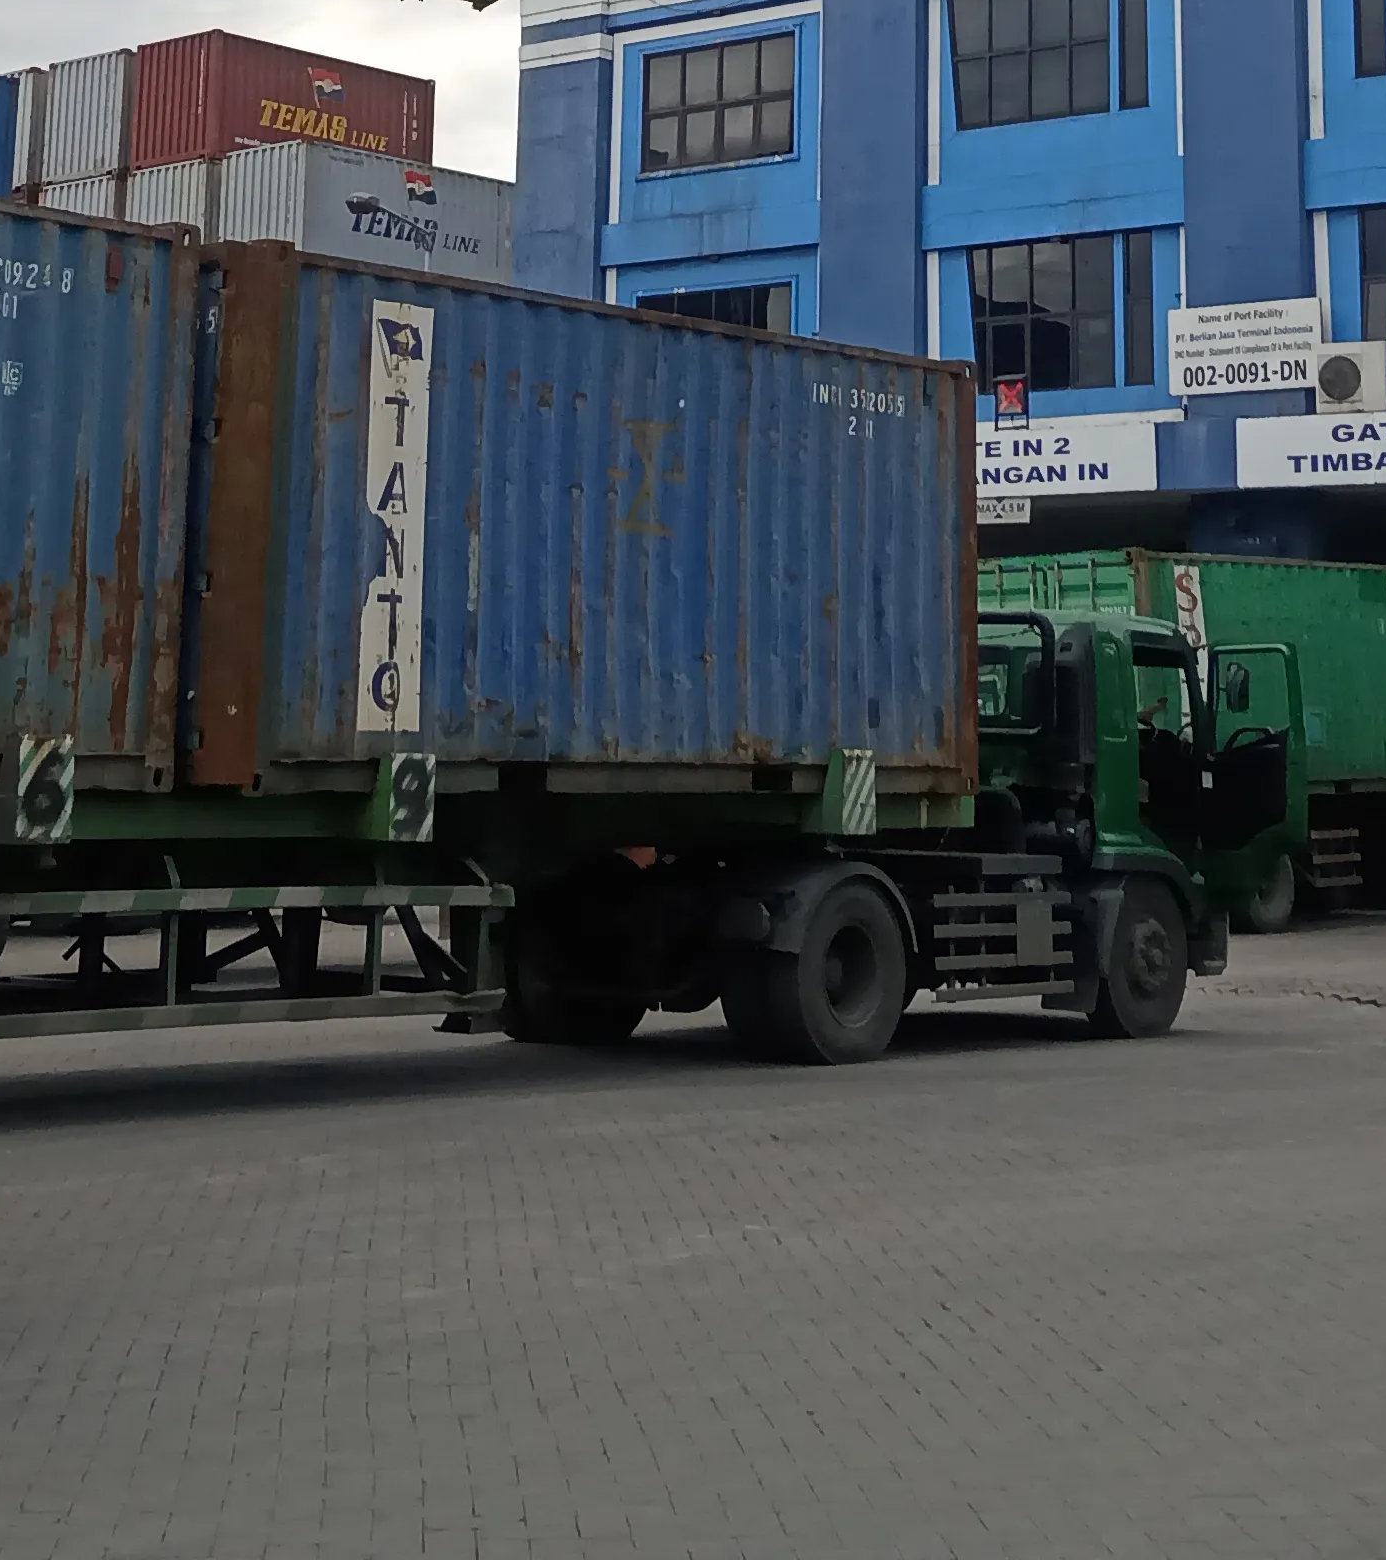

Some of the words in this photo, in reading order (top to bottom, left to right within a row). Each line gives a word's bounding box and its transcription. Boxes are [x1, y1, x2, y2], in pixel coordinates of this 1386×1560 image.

[259, 99, 348, 142] TEMAS
[351, 130, 390, 152] LINE
[441, 233, 482, 255] LINE
[1198, 314, 1221, 324] Name
[1223, 312, 1232, 322] of
[1234, 310, 1251, 321] Port
[1253, 307, 1284, 320] Facility
[1189, 332, 1216, 343] Berlian
[1218, 330, 1235, 341] Jasa
[1237, 326, 1271, 339] Terminal
[1273, 323, 1313, 334] Indonesia
[1183, 359, 1307, 388] 002-0091-DN
[1013, 439, 1042, 456] IN
[1053, 437, 1070, 454] 2
[976, 464, 1067, 485] NGAN
[1078, 463, 1108, 481] IN
[976, 503, 997, 513] MAX
[1016, 503, 1025, 513] M
[371, 396, 410, 712] TANTO
[23, 746, 65, 828] 6
